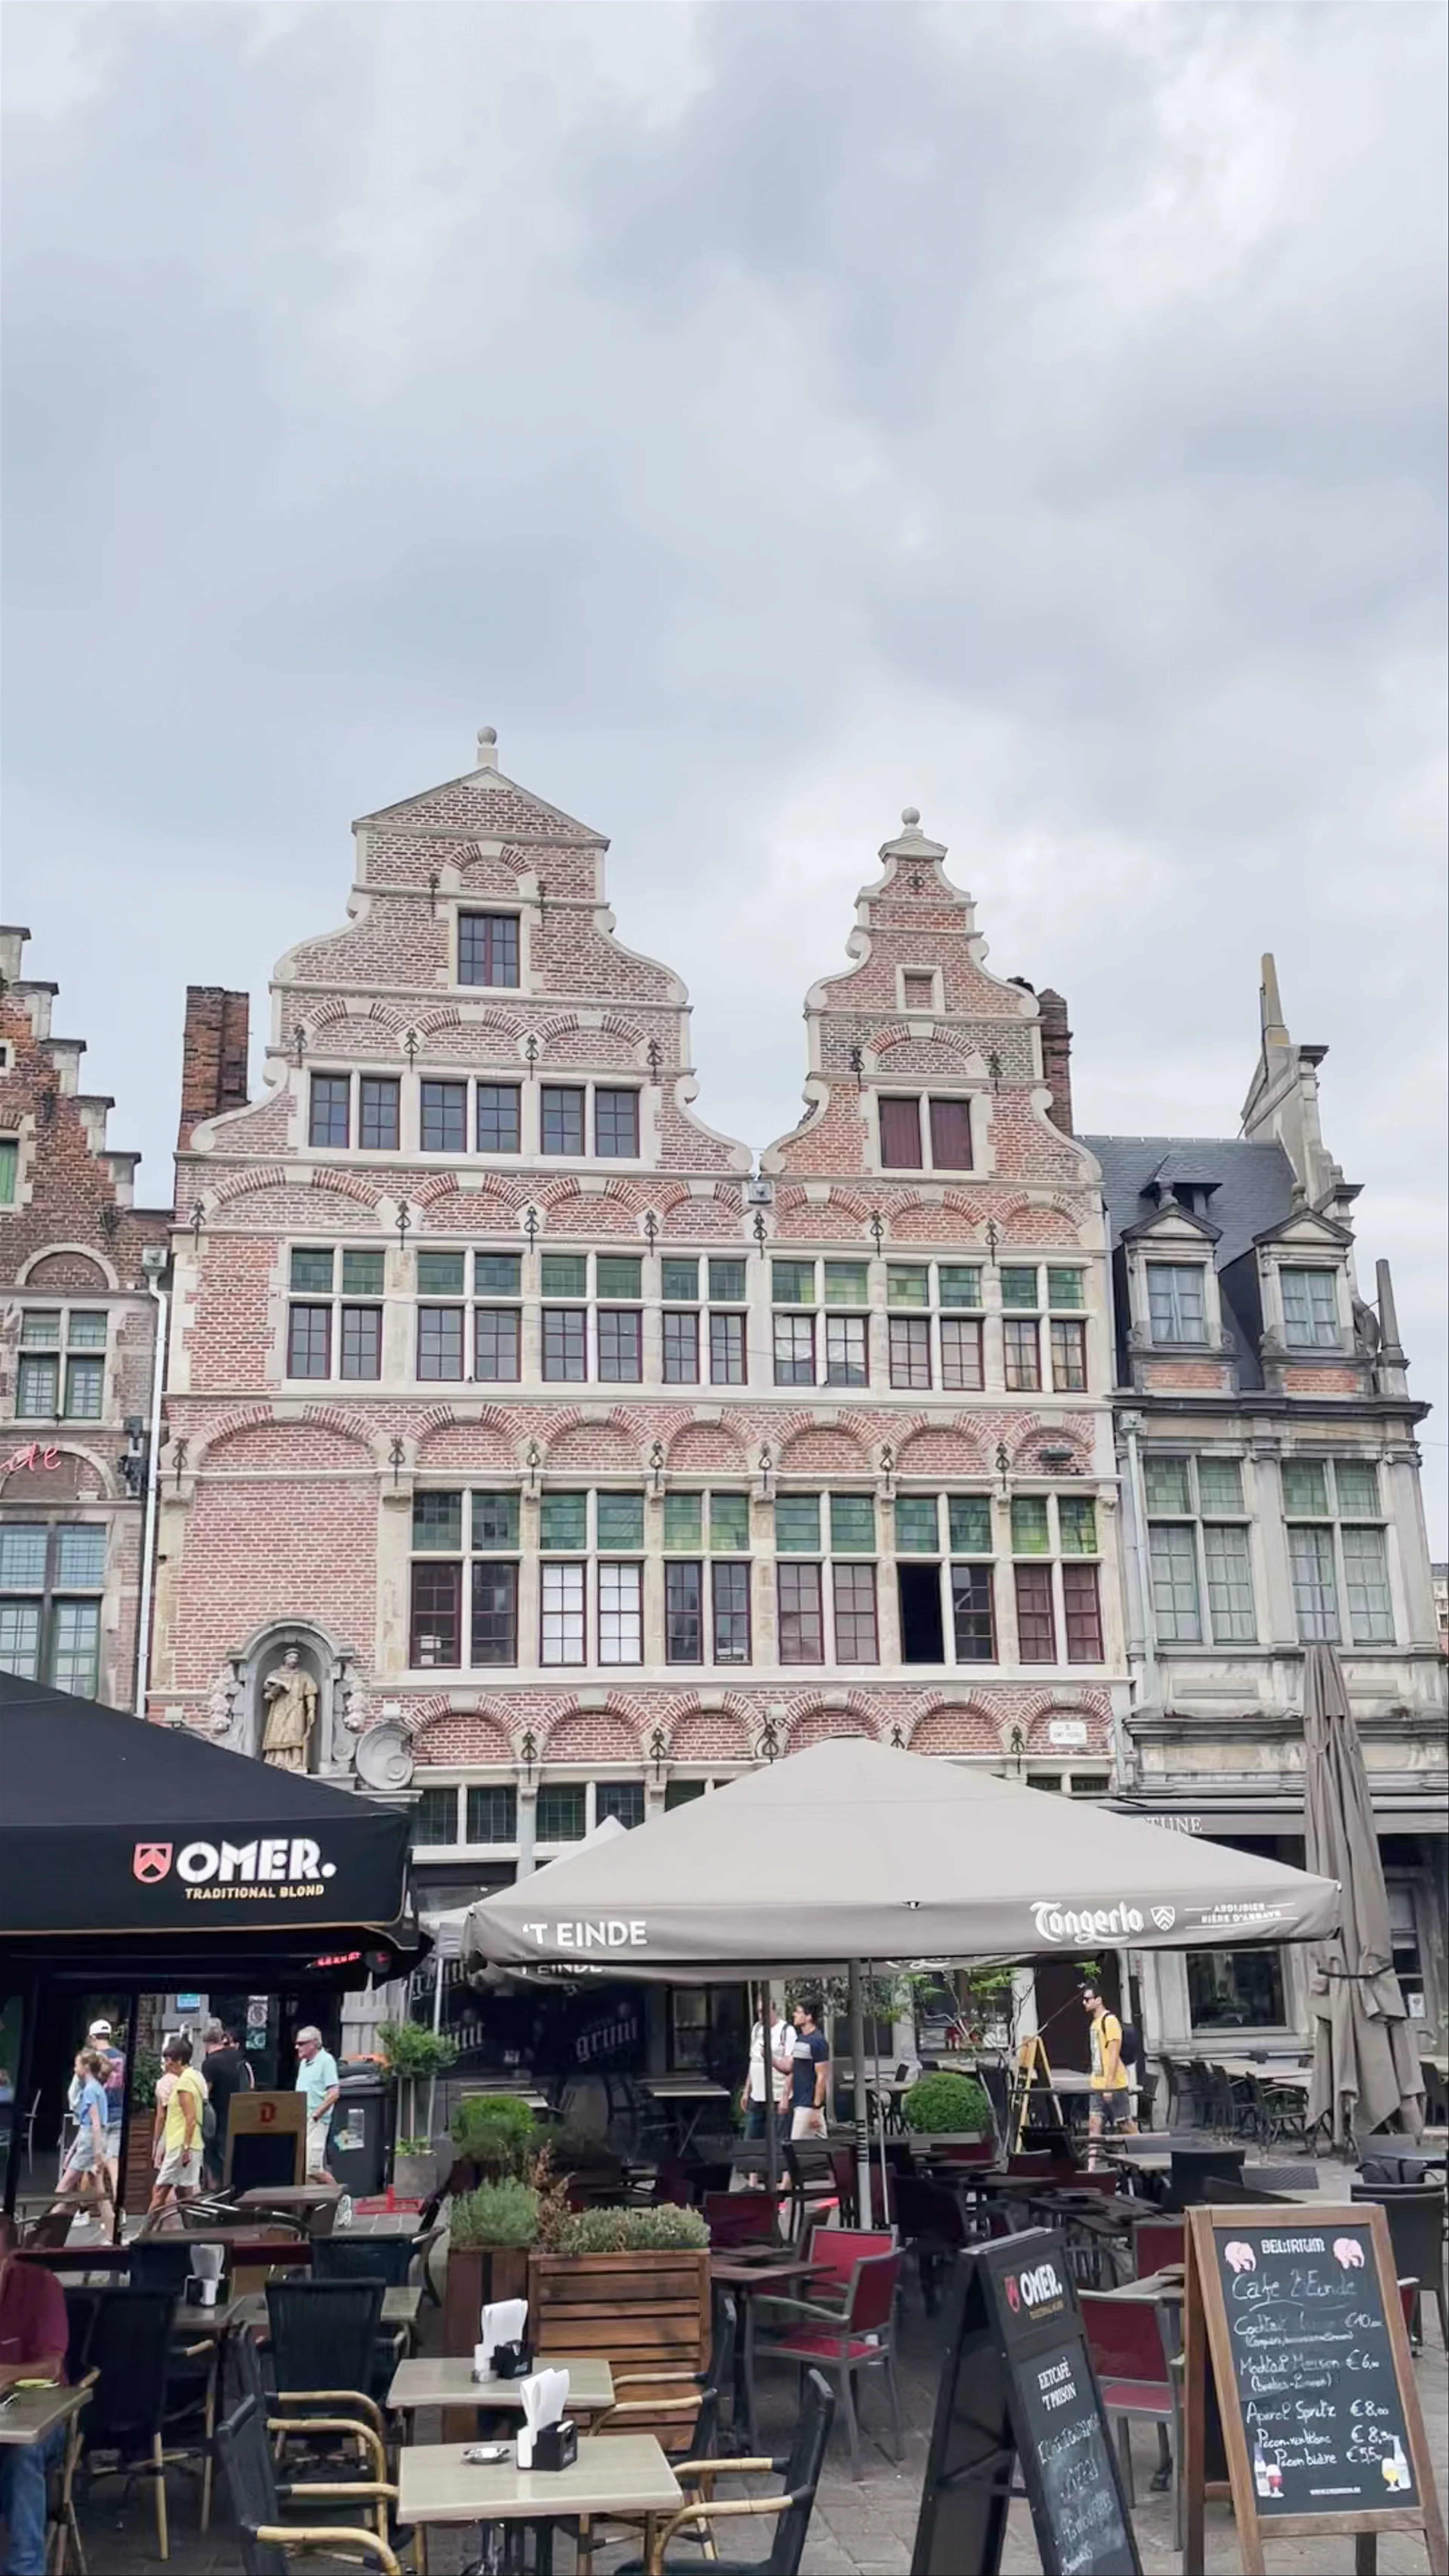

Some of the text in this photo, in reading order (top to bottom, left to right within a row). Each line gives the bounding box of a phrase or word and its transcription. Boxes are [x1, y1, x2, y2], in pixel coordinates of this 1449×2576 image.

[185, 1884, 324, 1899] TRADITIONAL BLOND
[1030, 1901, 1144, 1944] Tongerlo
[557, 1921, 648, 1947] EINDE
[1261, 2238, 1325, 2254] DELIRIUM
